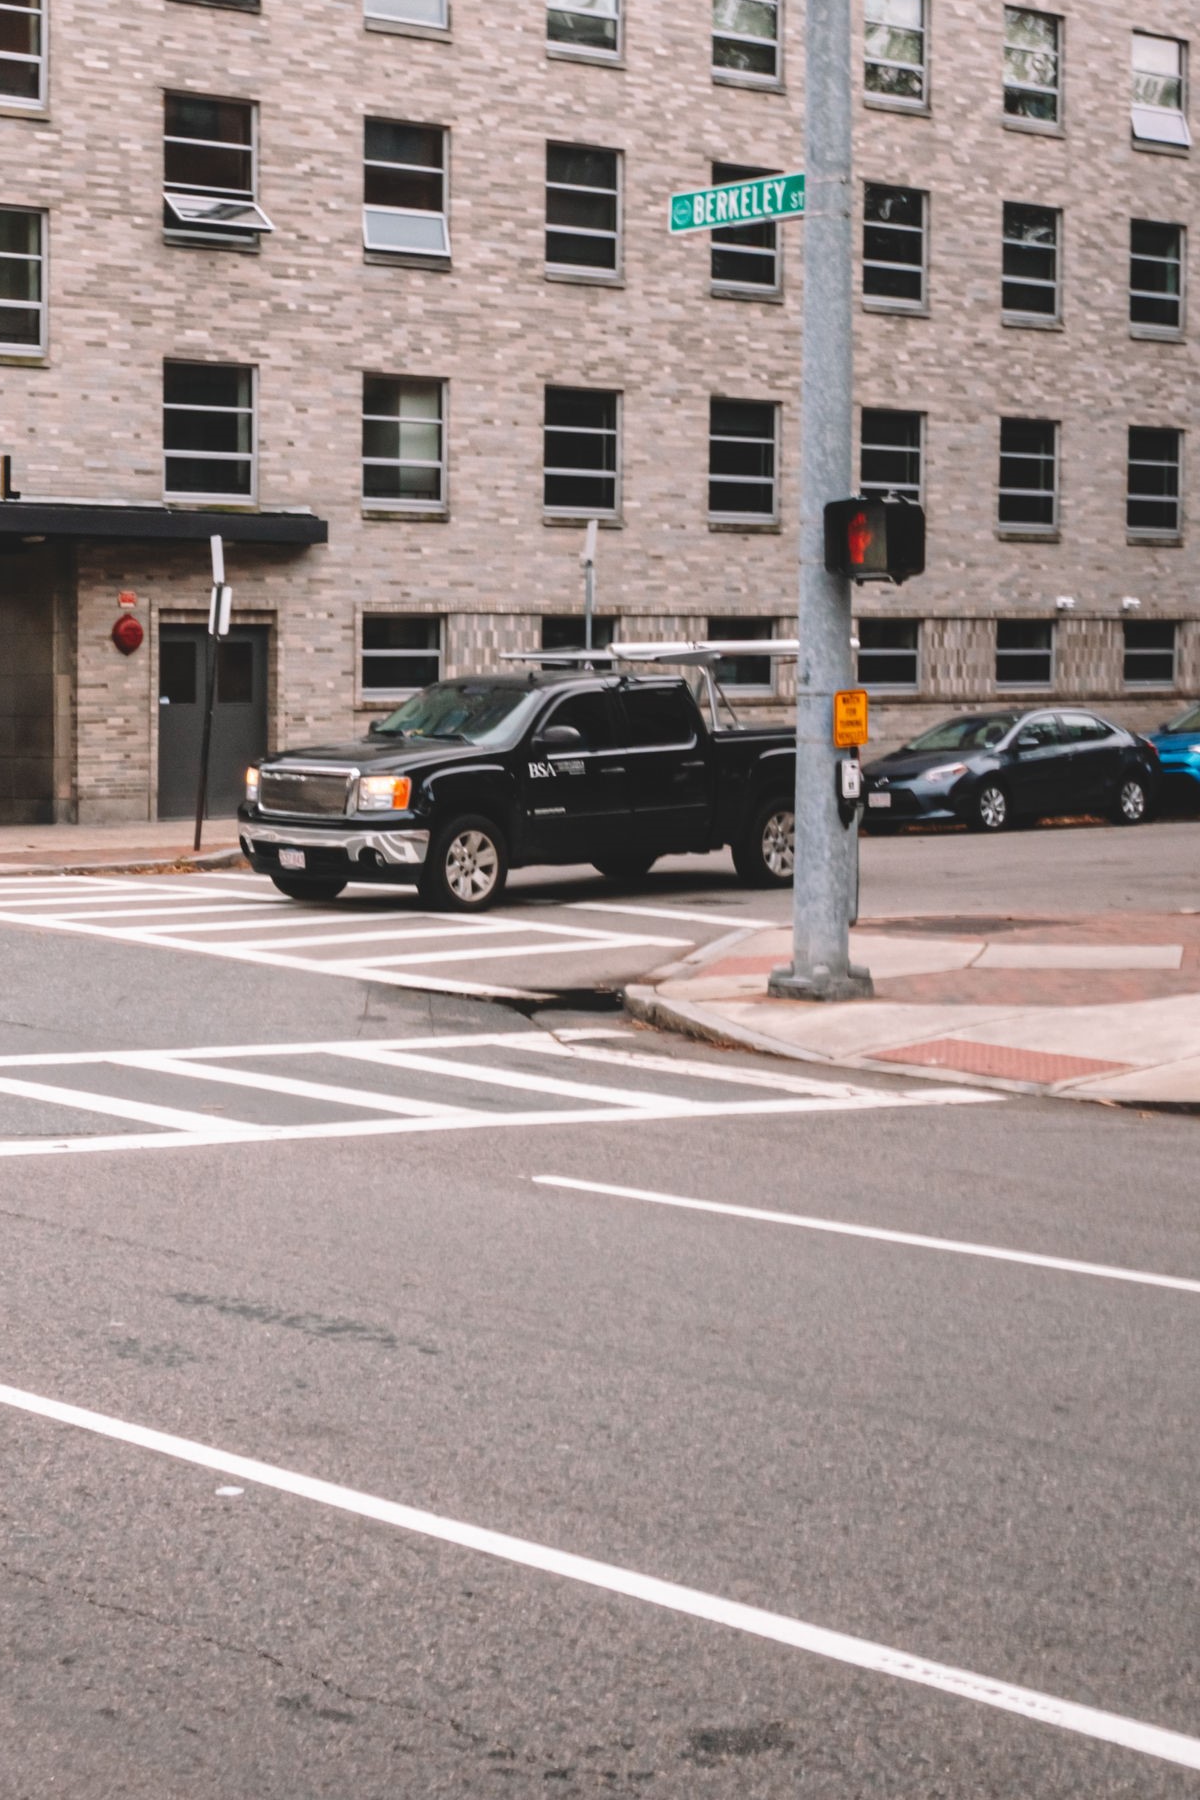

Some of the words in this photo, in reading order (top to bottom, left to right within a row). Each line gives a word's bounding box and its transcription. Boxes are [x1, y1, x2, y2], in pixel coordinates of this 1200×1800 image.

[693, 180, 786, 225] BERKELEY
[790, 191, 805, 209] ST
[528, 761, 557, 778] BSA
